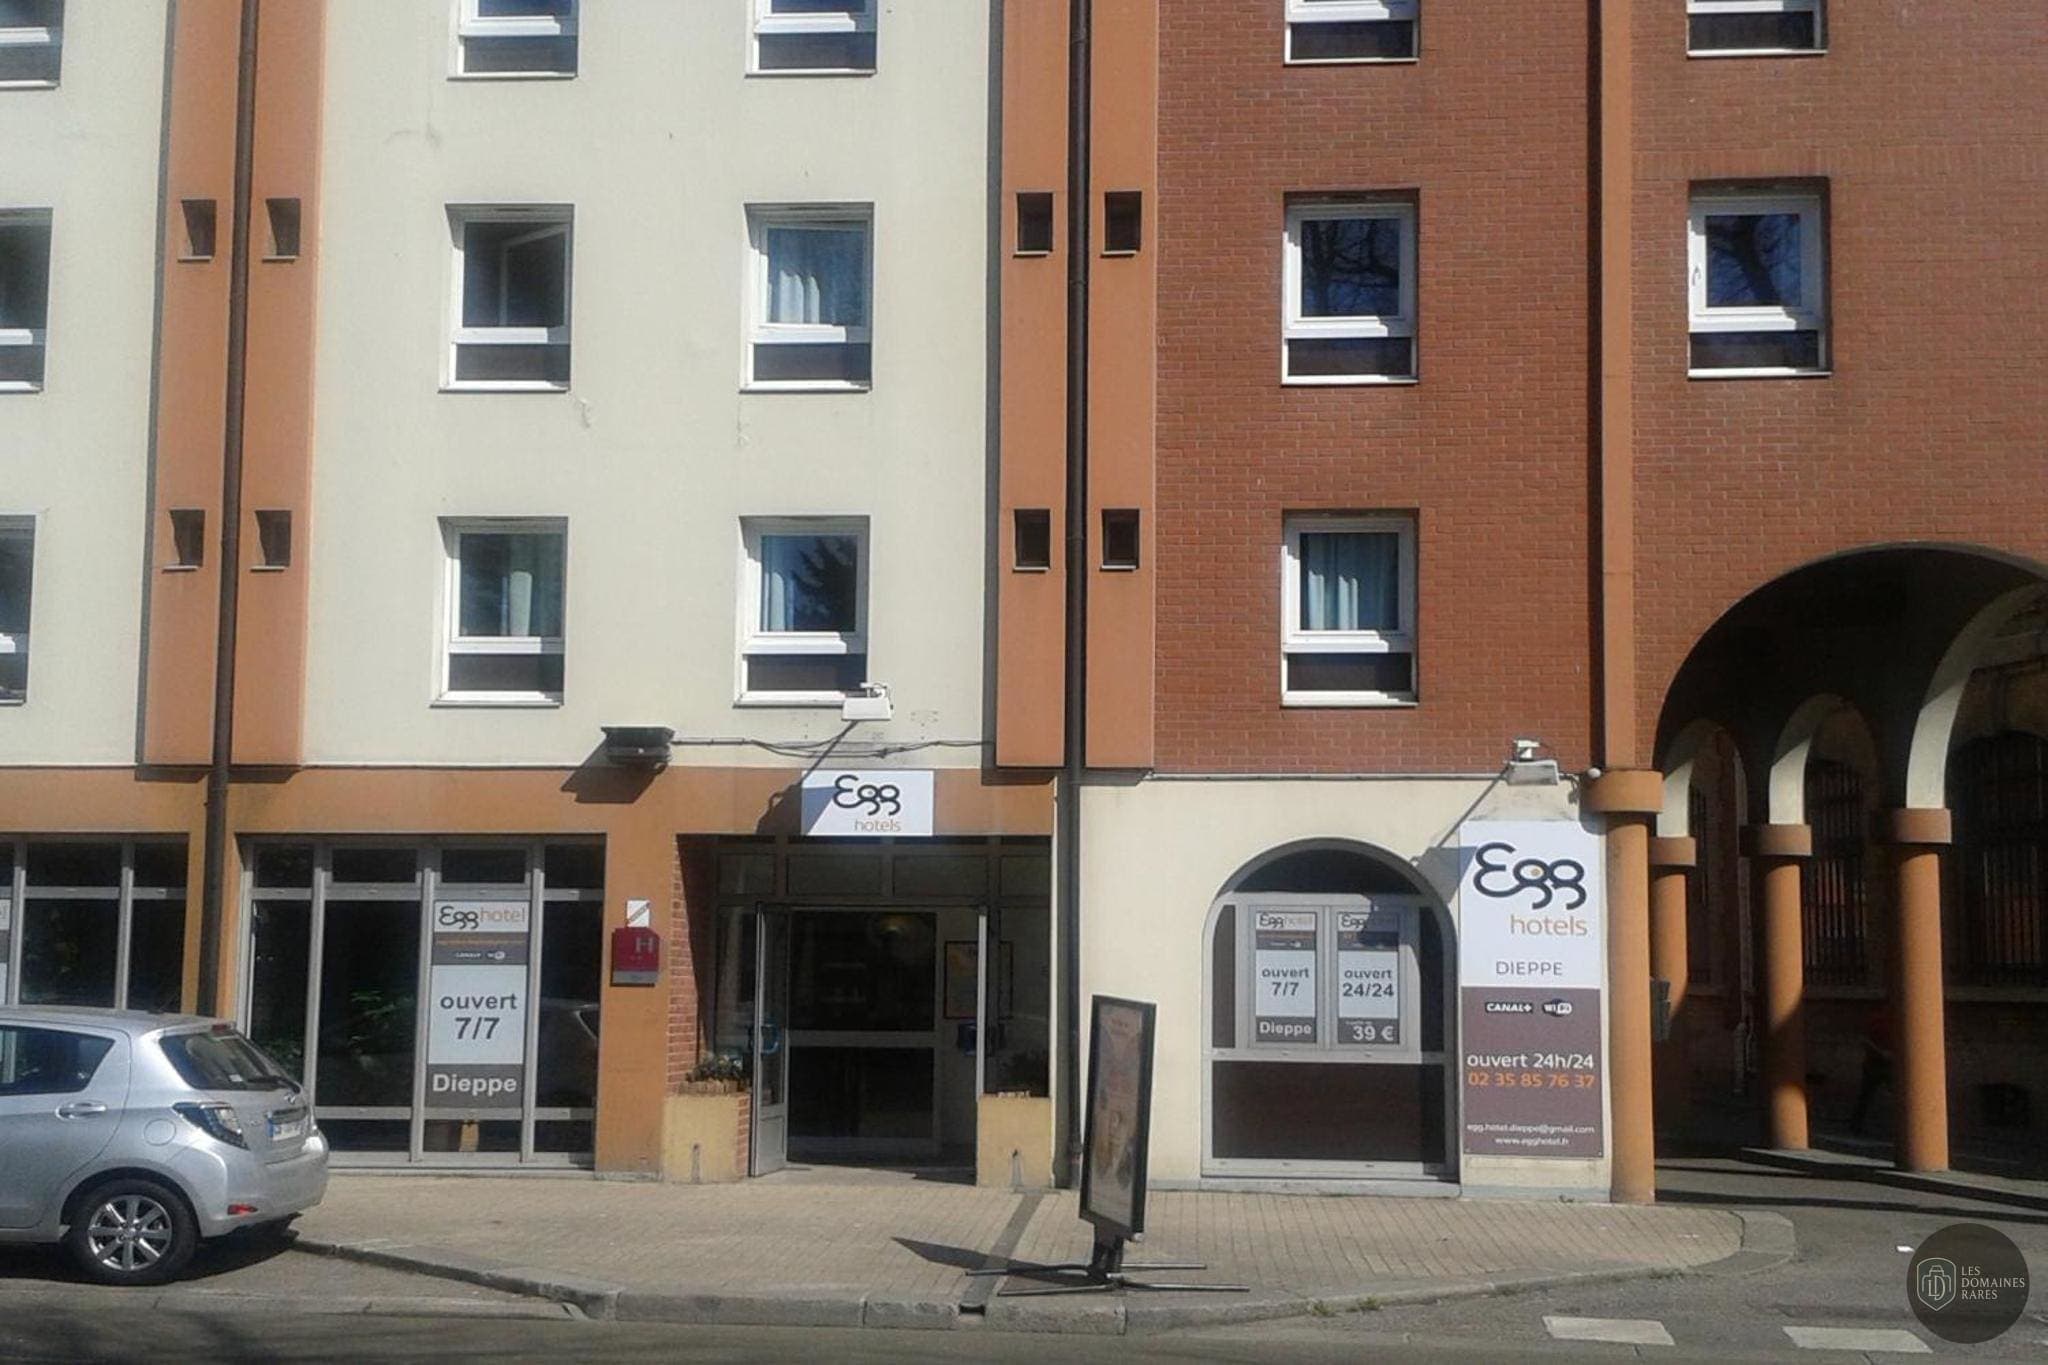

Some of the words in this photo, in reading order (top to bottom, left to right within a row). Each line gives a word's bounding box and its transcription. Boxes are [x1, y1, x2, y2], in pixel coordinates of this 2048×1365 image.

[833, 774, 901, 816] Egg
[854, 819, 902, 832] hotels
[1473, 842, 1587, 910] Egg
[1511, 913, 1587, 936] hotels
[1262, 967, 1310, 979] ouvert
[1344, 968, 1392, 979] ouvert
[1496, 960, 1562, 976] DIEPPE
[1271, 981, 1299, 996] 7/7
[1342, 982, 1394, 998] 24/24
[440, 993, 518, 1010] ouvert
[1485, 1002, 1532, 1013] CANAL+
[455, 1016, 500, 1040] 7/7
[1259, 1021, 1313, 1037] Dieppe
[1353, 1025, 1376, 1041] 39
[1381, 1025, 1394, 1041] €
[1467, 1054, 1528, 1068] ouvert
[1533, 1053, 1594, 1069] 24h/24
[432, 1073, 517, 1096] Dieppe
[1468, 1072, 1490, 1087] 02
[1494, 1072, 1516, 1087] 35
[1520, 1072, 1543, 1088] 85
[1547, 1073, 1570, 1088] 76
[1575, 1073, 1596, 1088] 37
